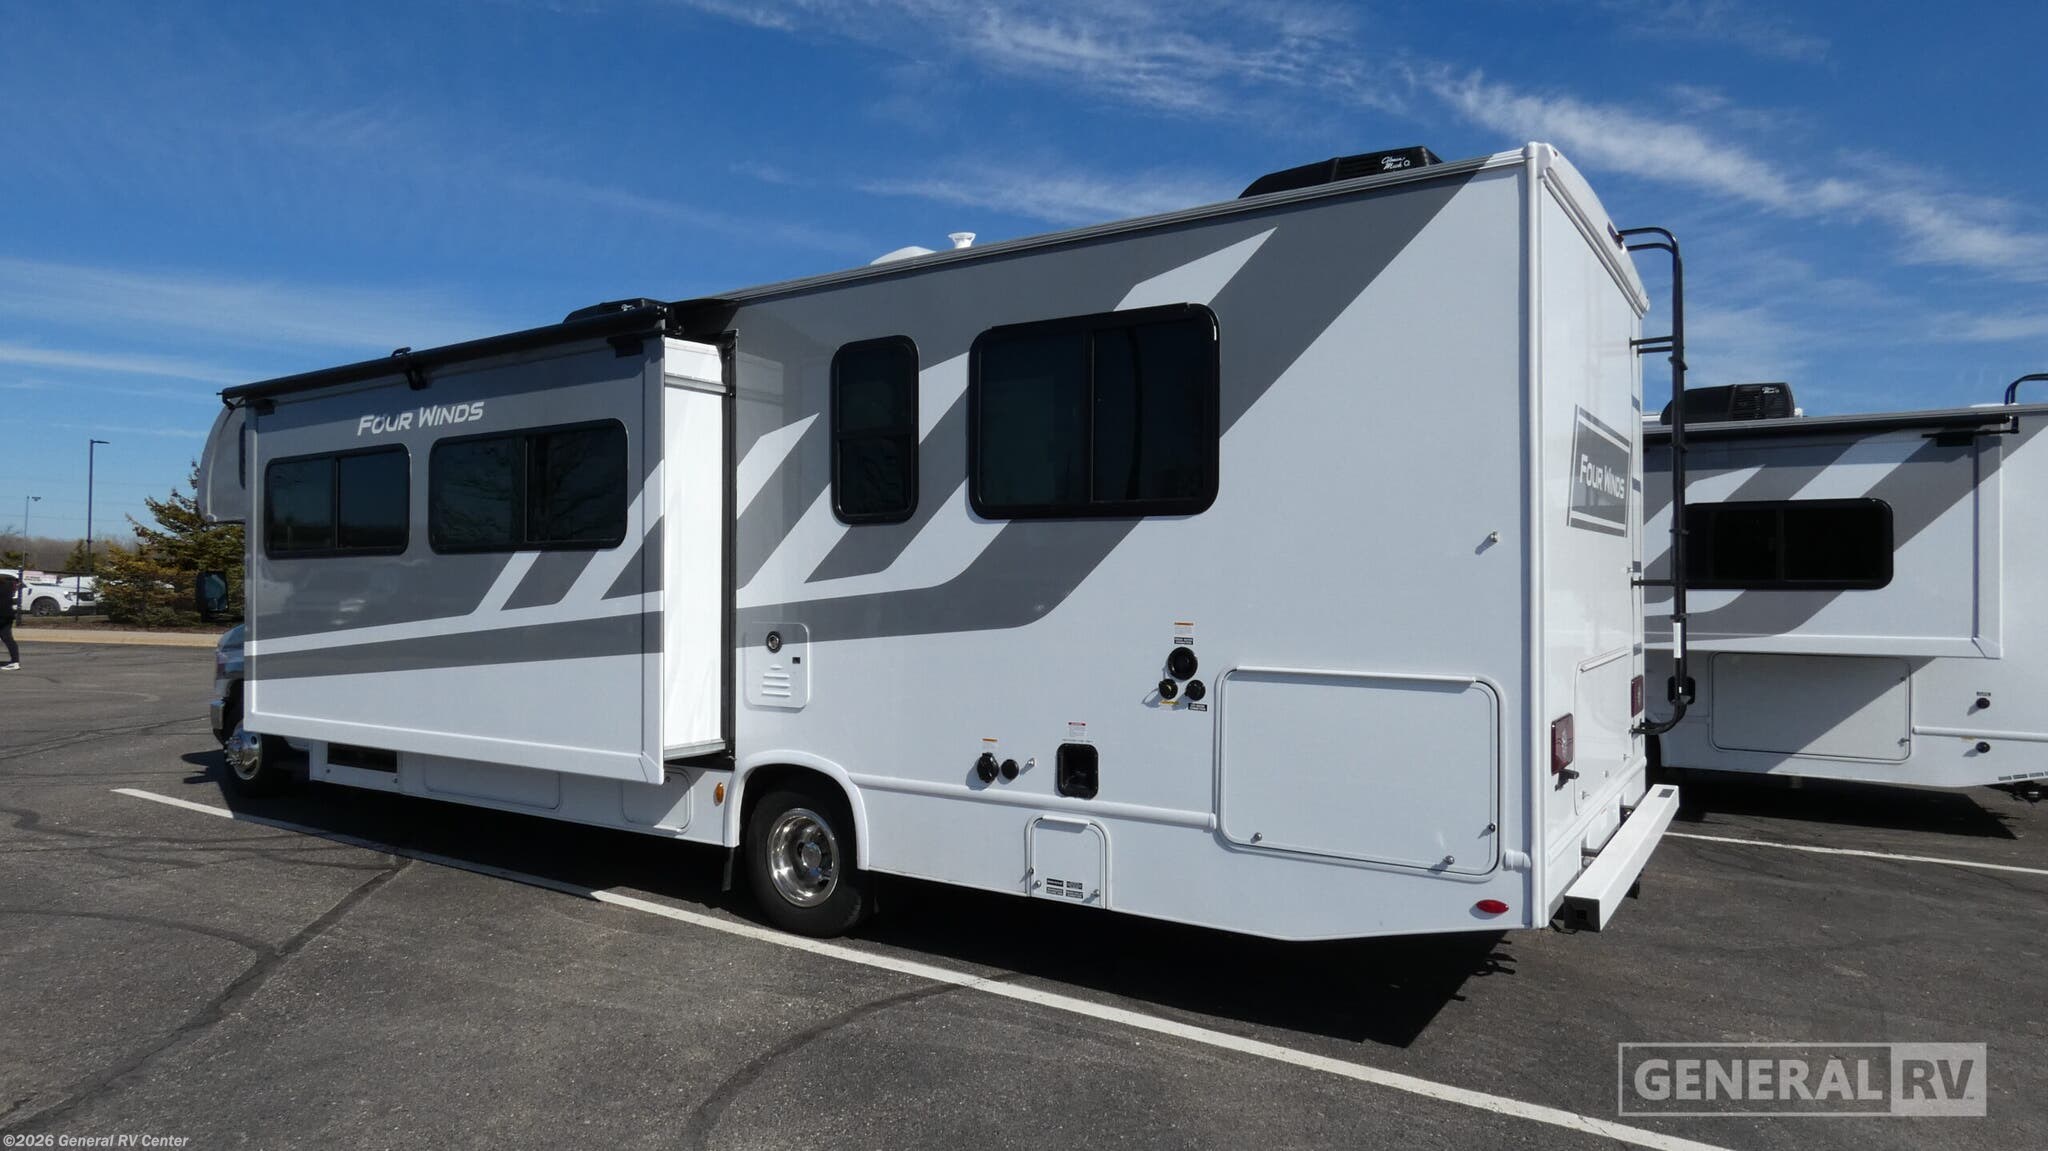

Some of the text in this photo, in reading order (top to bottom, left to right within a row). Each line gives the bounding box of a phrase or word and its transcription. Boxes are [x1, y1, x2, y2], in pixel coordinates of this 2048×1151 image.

[357, 401, 485, 436] FOUR WINDS
[1579, 453, 1625, 499] FOUR WINDS
